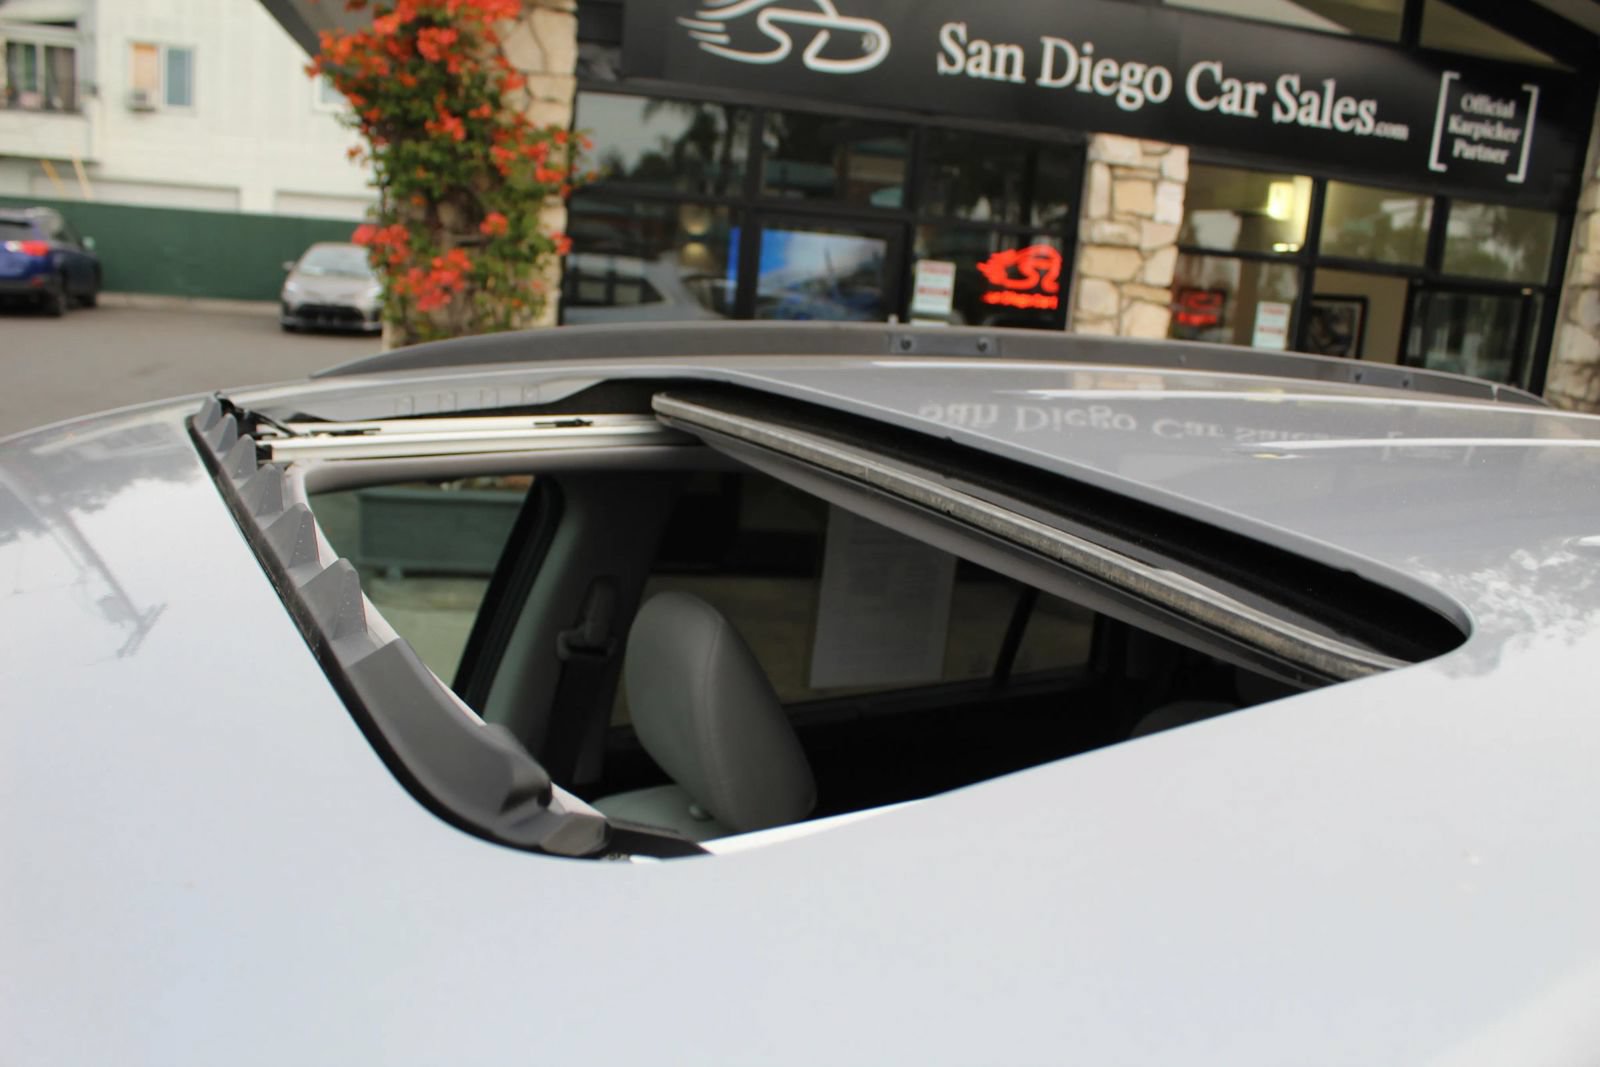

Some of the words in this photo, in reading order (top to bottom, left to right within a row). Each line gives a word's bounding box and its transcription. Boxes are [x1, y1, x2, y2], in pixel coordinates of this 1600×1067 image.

[937, 21, 1026, 84] San
[1037, 35, 1172, 111] Diego
[1185, 61, 1266, 118] Car
[1452, 138, 1510, 165] Partner
